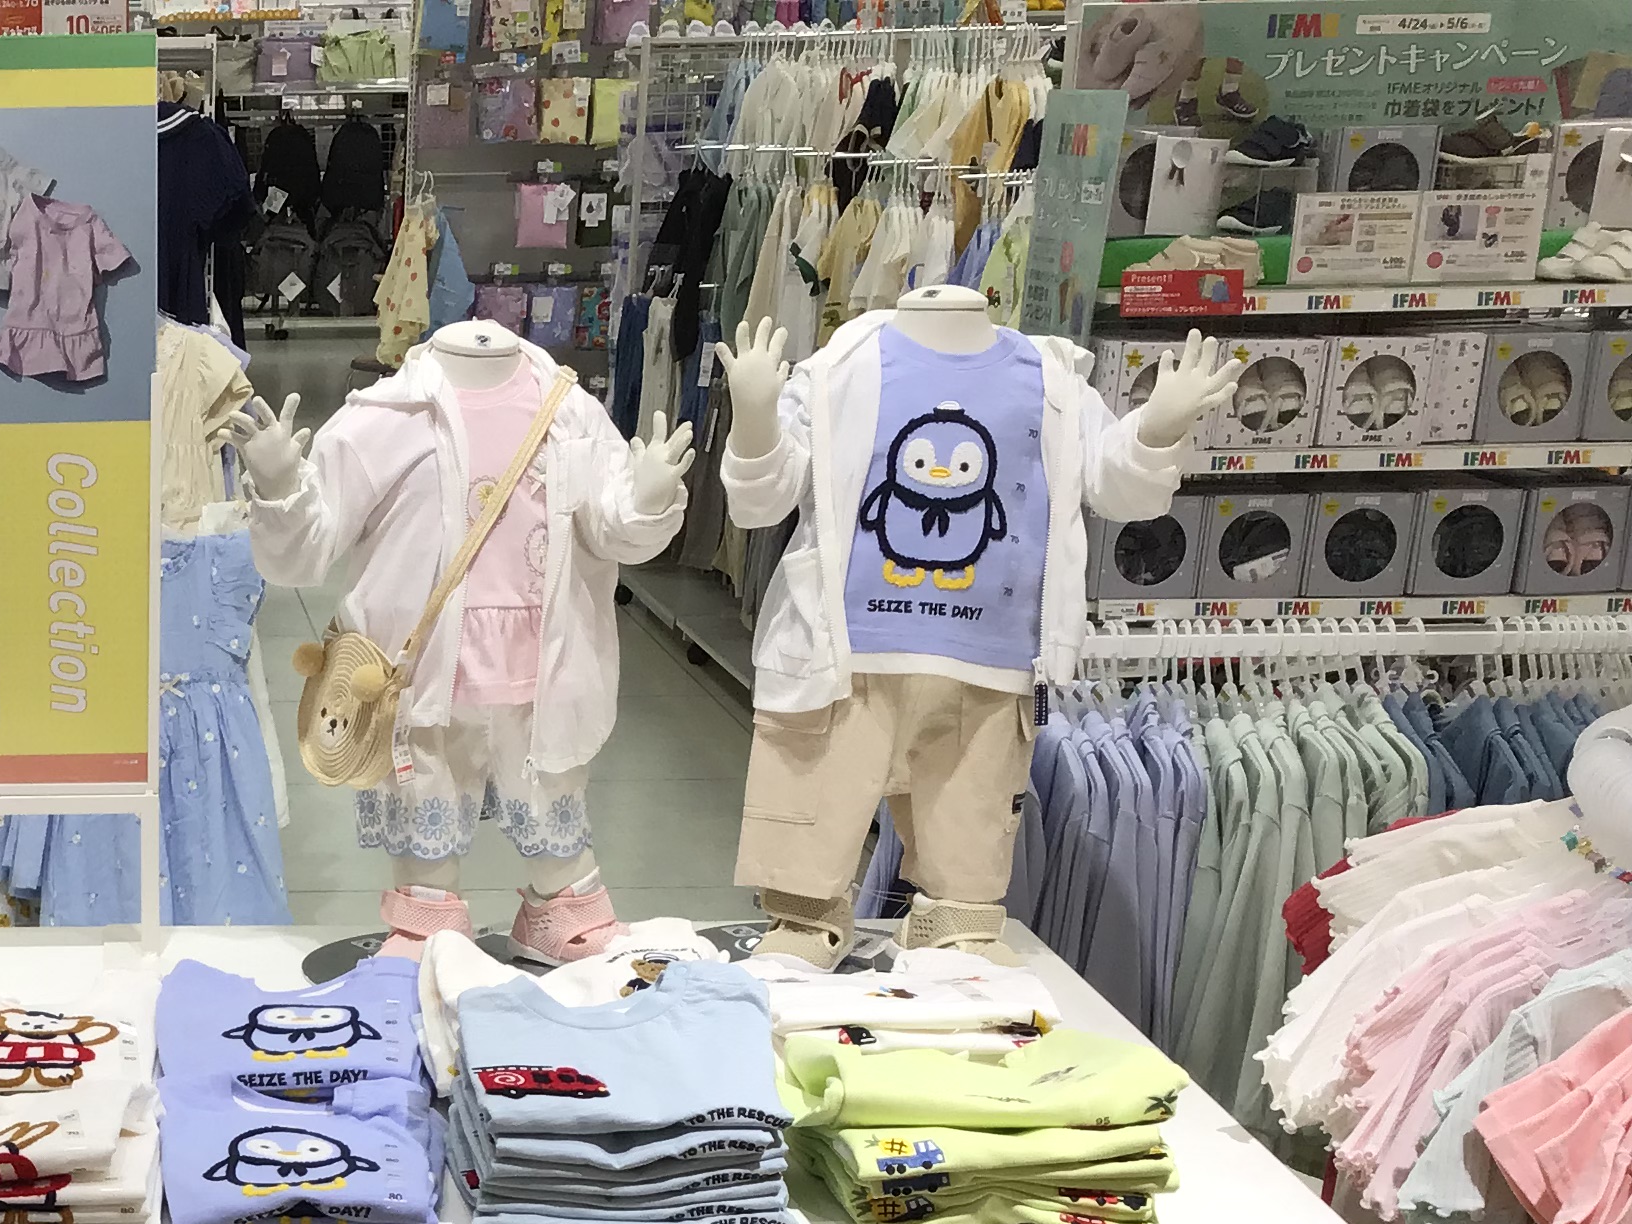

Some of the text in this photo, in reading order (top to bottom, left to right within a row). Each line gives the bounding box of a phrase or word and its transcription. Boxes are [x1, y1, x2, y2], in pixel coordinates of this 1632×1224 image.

[1267, 13, 1340, 38] IFME
[1265, 37, 1568, 80] プレゼントキャンペーン
[1243, 296, 1267, 311] ME
[1307, 294, 1352, 310] IFME
[1392, 293, 1437, 308] IFME
[1477, 291, 1522, 306] IFME
[1562, 289, 1607, 304] IFME
[1211, 455, 1255, 471] IFME
[1295, 454, 1340, 469] IFME
[1379, 453, 1424, 467] IFME
[1464, 451, 1508, 466] IFME
[1548, 450, 1592, 464] IFME
[47, 450, 99, 715] Collection
[867, 599, 984, 622] SEIZE THE DAY!
[1194, 602, 1239, 616] IFME
[1277, 601, 1322, 616] IFME
[1360, 600, 1404, 615] IFME
[1442, 600, 1486, 615] IFME
[1525, 598, 1568, 613] IFME
[236, 1069, 369, 1087] SEIZE THE DAY!
[688, 1114, 706, 1126] TO
[707, 1107, 735, 1121] THE
[679, 1140, 767, 1159] TO THE RESC
[703, 1173, 729, 1186] THE
[688, 1204, 715, 1217] THE
